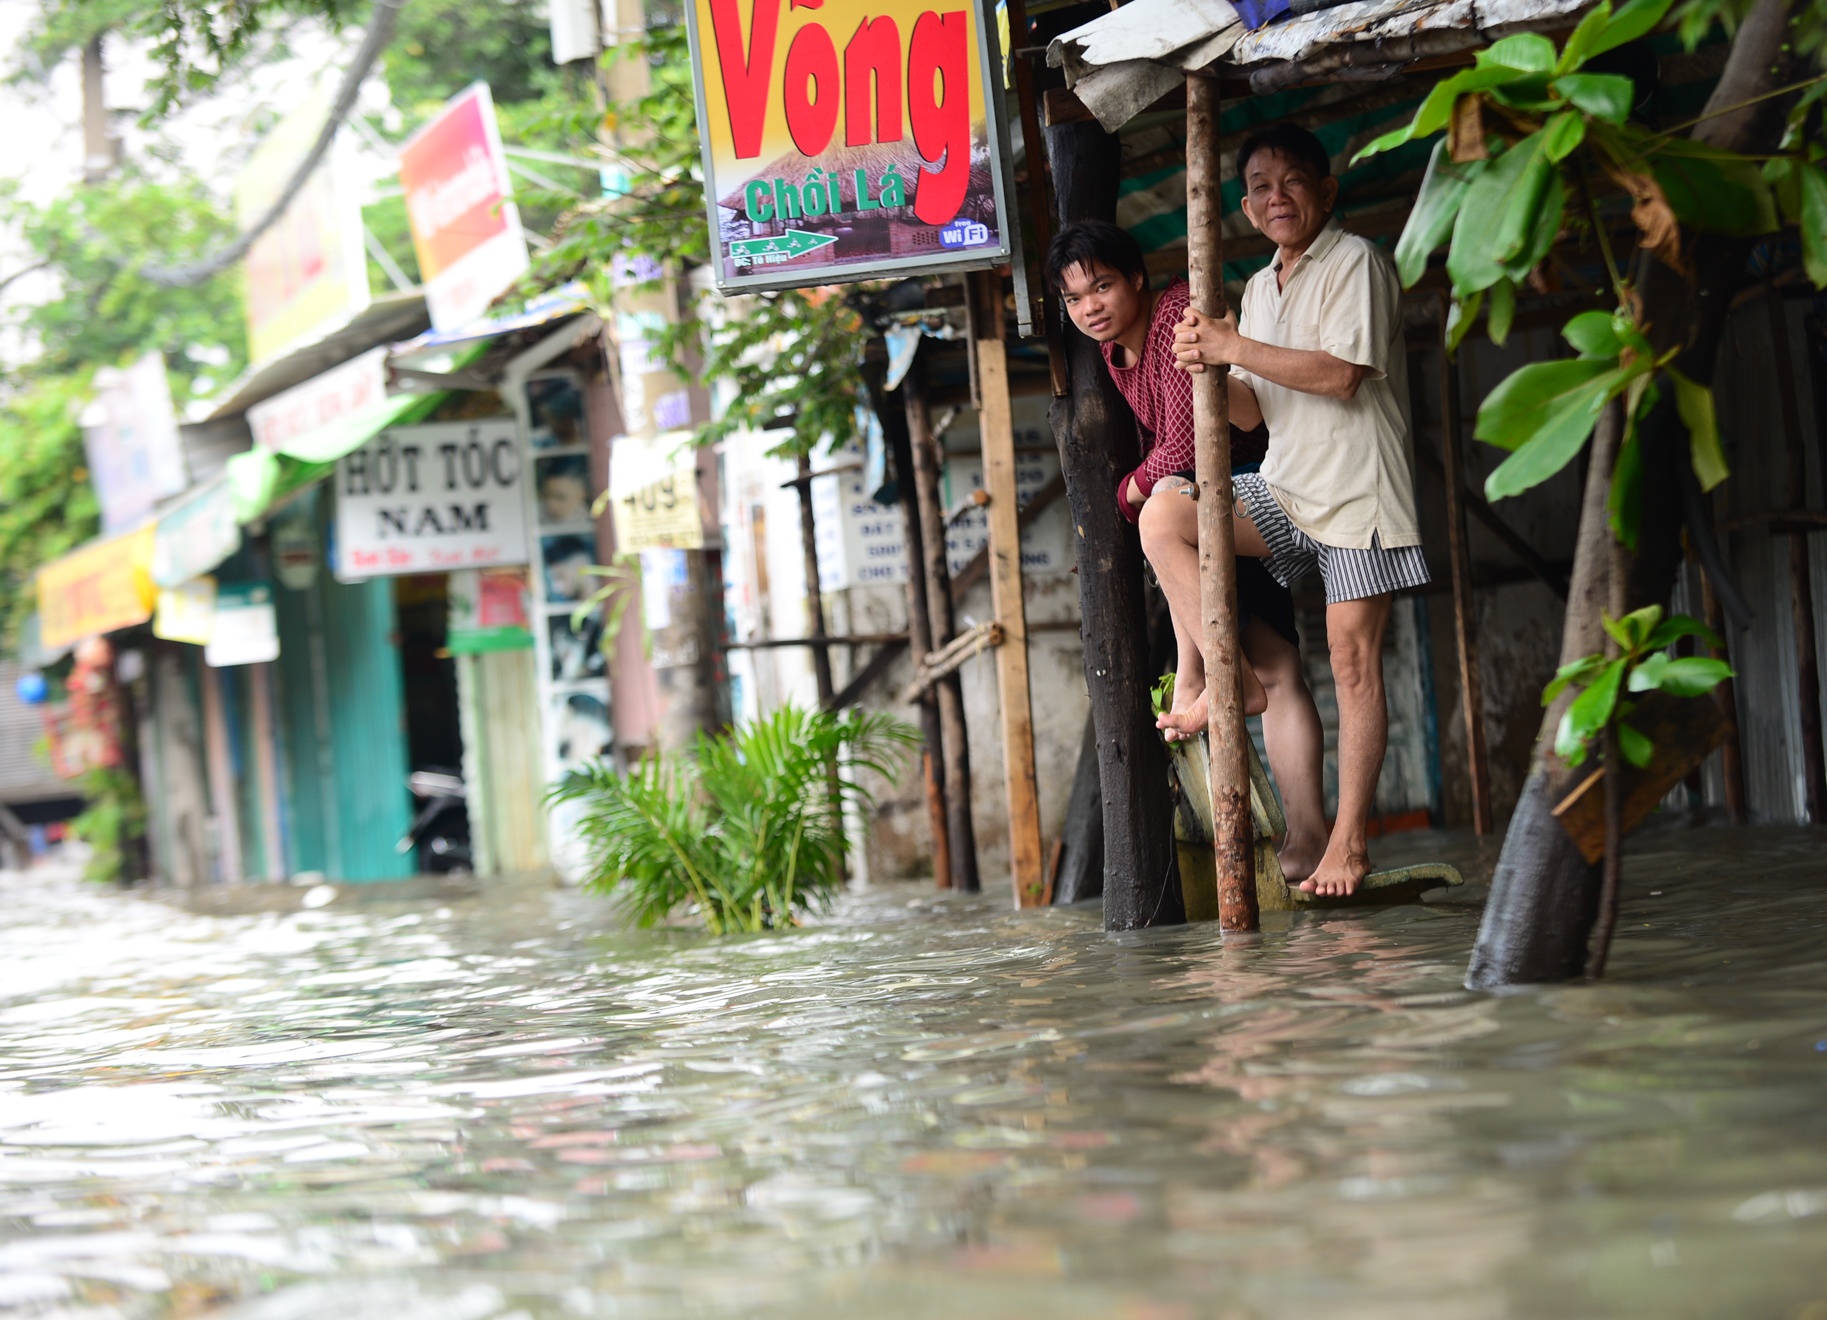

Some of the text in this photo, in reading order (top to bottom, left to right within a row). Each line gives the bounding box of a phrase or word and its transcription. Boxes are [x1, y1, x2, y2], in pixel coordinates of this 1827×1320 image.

[745, 164, 906, 223] Chồi Lá
[439, 428, 518, 490] TÓC
[378, 503, 489, 538] NAM
